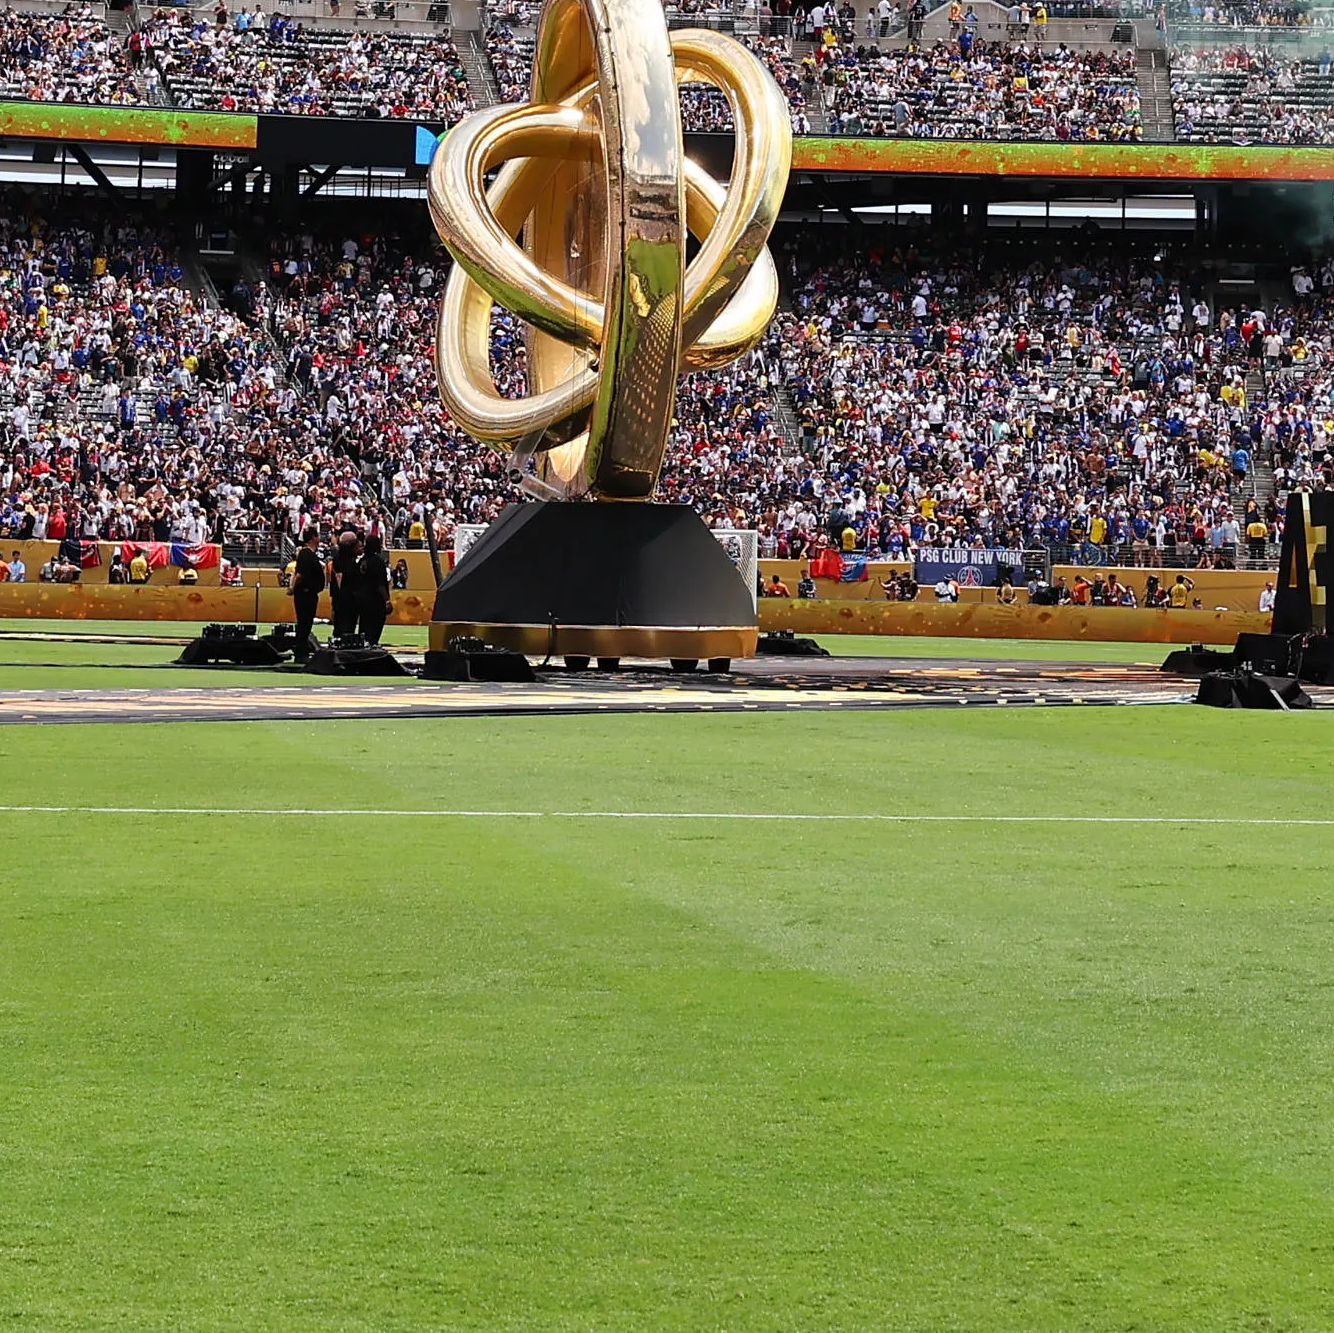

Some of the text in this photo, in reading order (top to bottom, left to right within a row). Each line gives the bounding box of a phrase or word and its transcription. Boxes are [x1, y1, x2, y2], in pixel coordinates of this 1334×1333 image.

[919, 549, 1023, 566] PSG CLUB NEW YORK
